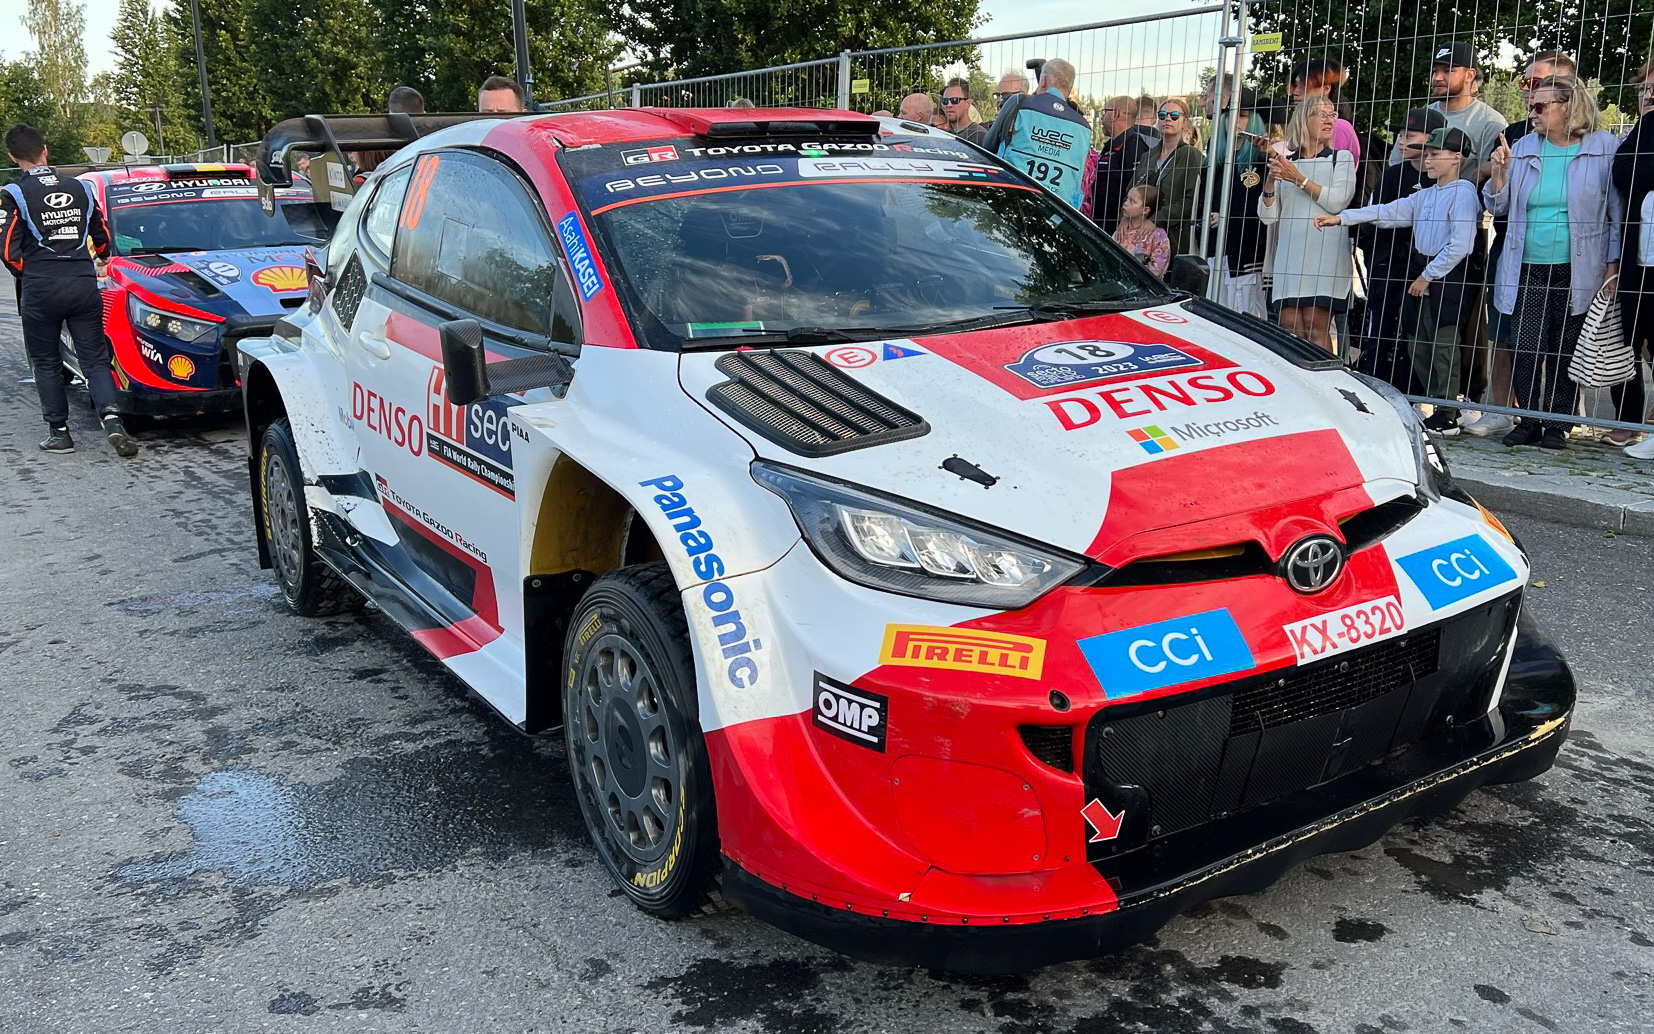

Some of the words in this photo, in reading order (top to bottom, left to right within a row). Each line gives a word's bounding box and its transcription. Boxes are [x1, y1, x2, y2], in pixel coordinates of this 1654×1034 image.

[1031, 125, 1075, 145] WRC
[685, 144, 793, 157] TOYOTA
[800, 142, 890, 152] GAZOO
[893, 144, 970, 159] Racing
[1037, 145, 1060, 157] MEDIA
[171, 178, 250, 189] HYUNDAI
[605, 164, 784, 193] BEYOND
[813, 162, 934, 172] RALLY
[1026, 160, 1064, 187] 192
[117, 191, 196, 204] BEYOND
[400, 155, 440, 230] 18
[41, 208, 81, 220] HYUNDAI
[42, 216, 82, 226] MOTORSPORT
[214, 264, 235, 274] 11
[1054, 344, 1116, 361] 18
[1091, 362, 1139, 375] 2023
[1043, 371, 1276, 431] DENSO
[352, 380, 424, 457] DENSO
[511, 421, 530, 443] PIAA
[1170, 411, 1280, 441] Microsoft
[443, 445, 454, 459] FIA
[452, 450, 467, 466] World
[467, 457, 480, 475] Rally
[480, 465, 515, 491] Championshi
[390, 490, 422, 518] TOYOTA
[422, 512, 454, 540] GAZOO
[455, 532, 488, 563] Racing
[637, 474, 763, 689] Panasonic
[579, 613, 603, 646] PIRELLI
[1288, 601, 1405, 659] KX-8320
[891, 630, 1034, 671] PIRELLI
[818, 690, 880, 732] OMP
[633, 786, 686, 888] SCORPION
